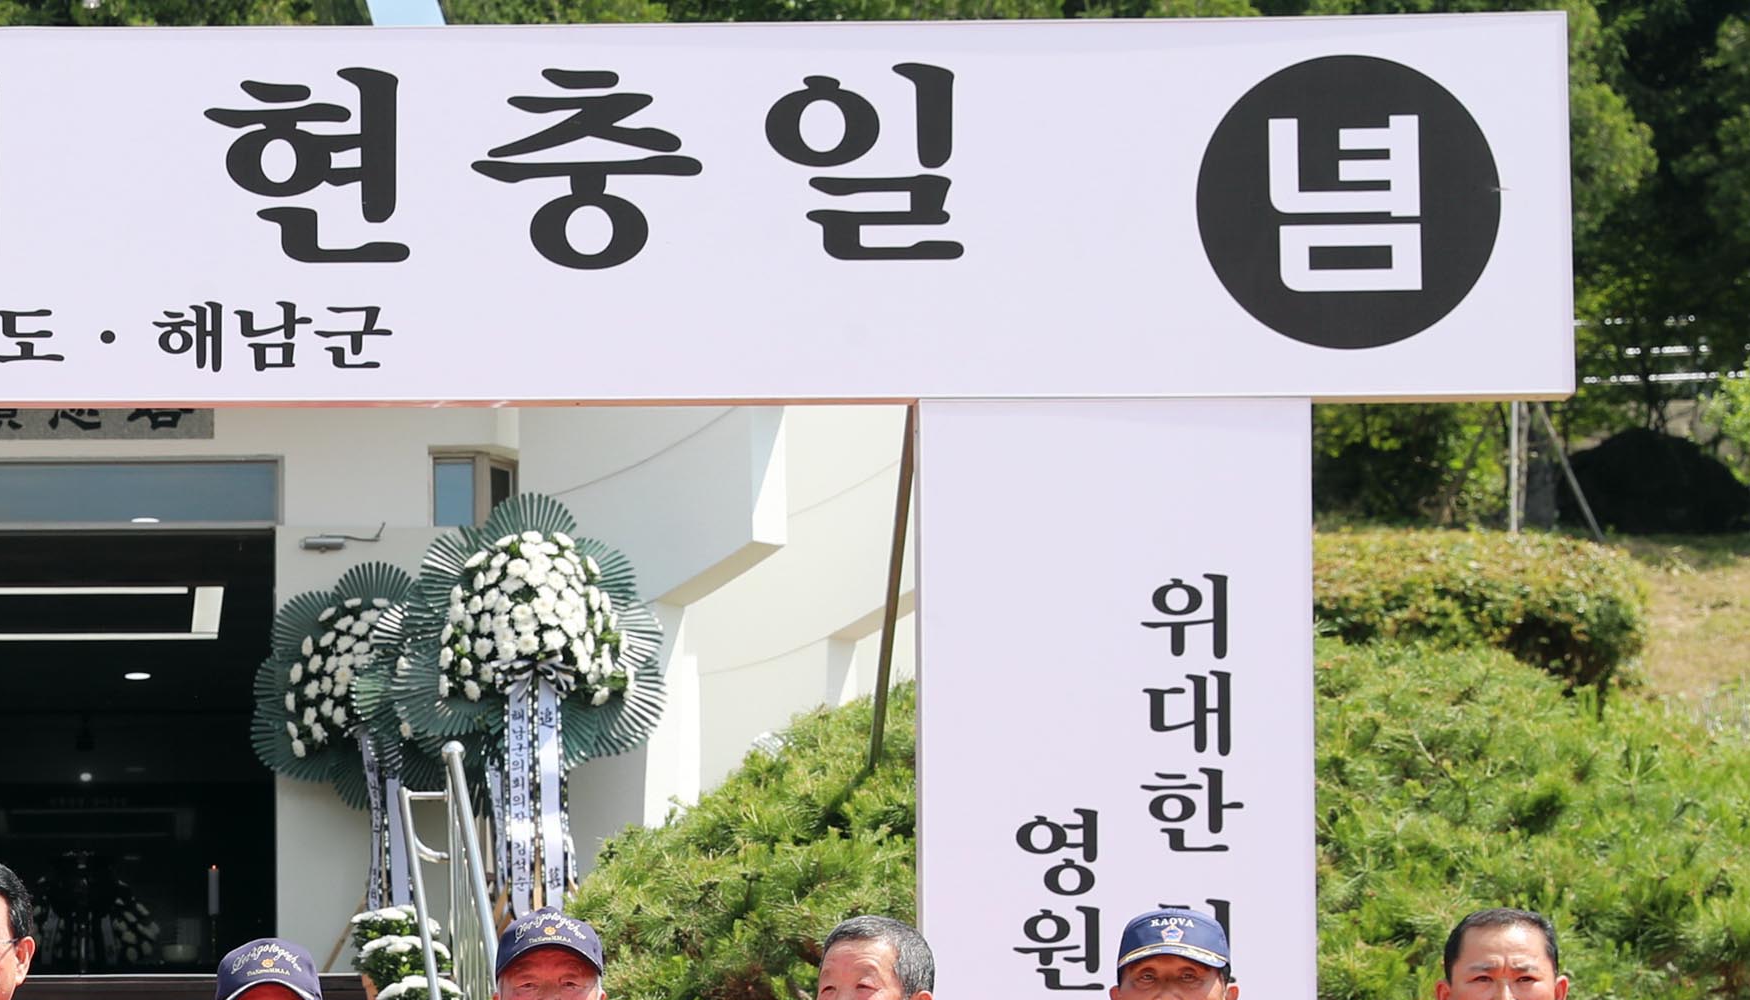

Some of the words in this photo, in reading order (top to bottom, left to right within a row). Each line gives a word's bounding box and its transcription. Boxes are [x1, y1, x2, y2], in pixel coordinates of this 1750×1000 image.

[204, 63, 963, 269] 현충일
[1269, 115, 1422, 292] 념
[152, 302, 393, 372] 해남군
[1140, 573, 1244, 852] 위대한
